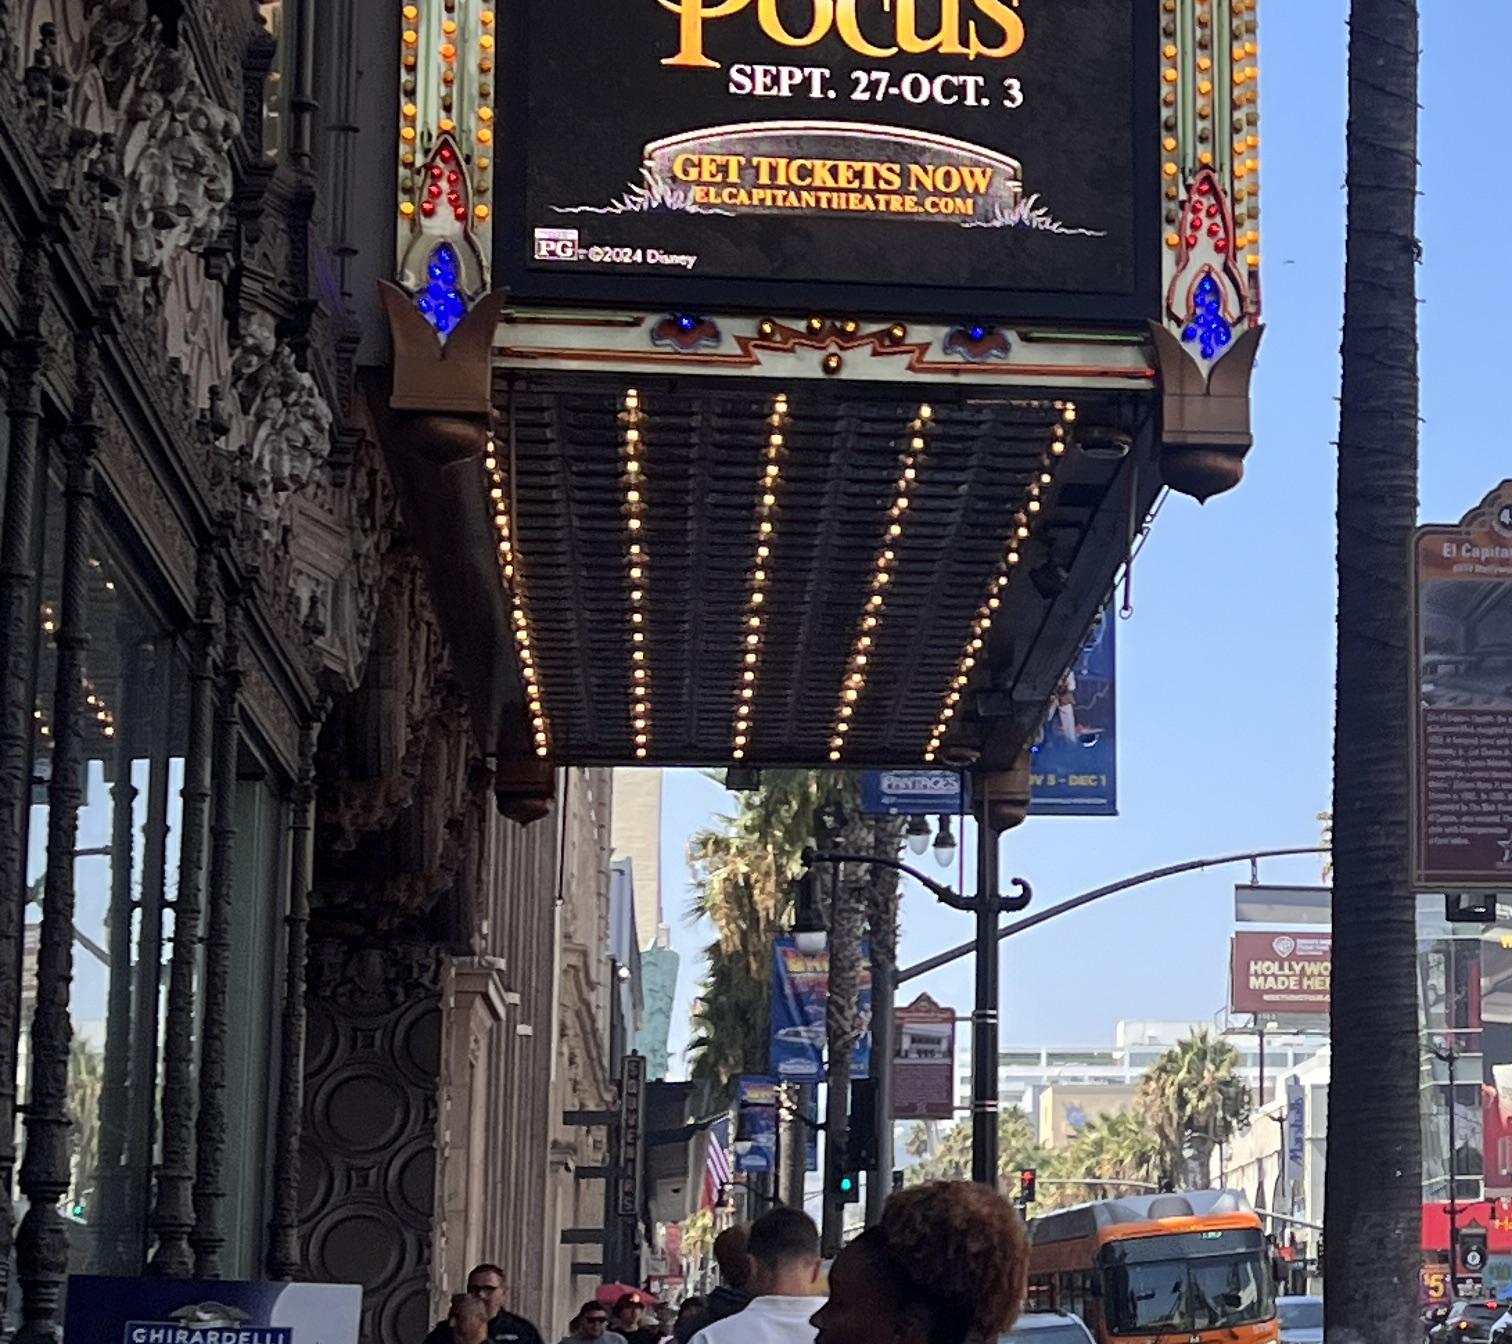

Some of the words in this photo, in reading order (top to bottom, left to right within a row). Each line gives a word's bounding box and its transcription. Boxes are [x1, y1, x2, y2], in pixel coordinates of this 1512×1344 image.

[729, 64, 837, 100] SEPT.
[850, 70, 991, 107] 27-OCT.
[1004, 76, 1025, 109] 3
[672, 153, 746, 184] GET
[753, 156, 901, 190] TICKETS
[909, 163, 993, 194] NOW
[694, 185, 975, 216] ELCAPITANTHEATRE.COM
[540, 240, 574, 257] PG
[646, 248, 697, 269] Disney
[1442, 542, 1457, 558] El
[883, 775, 958, 792] PANTAGES
[1068, 774, 1098, 787] DEC
[1249, 960, 1331, 975] HOLLYWO
[1249, 976, 1299, 990] MADE
[1303, 976, 1331, 991] HE
